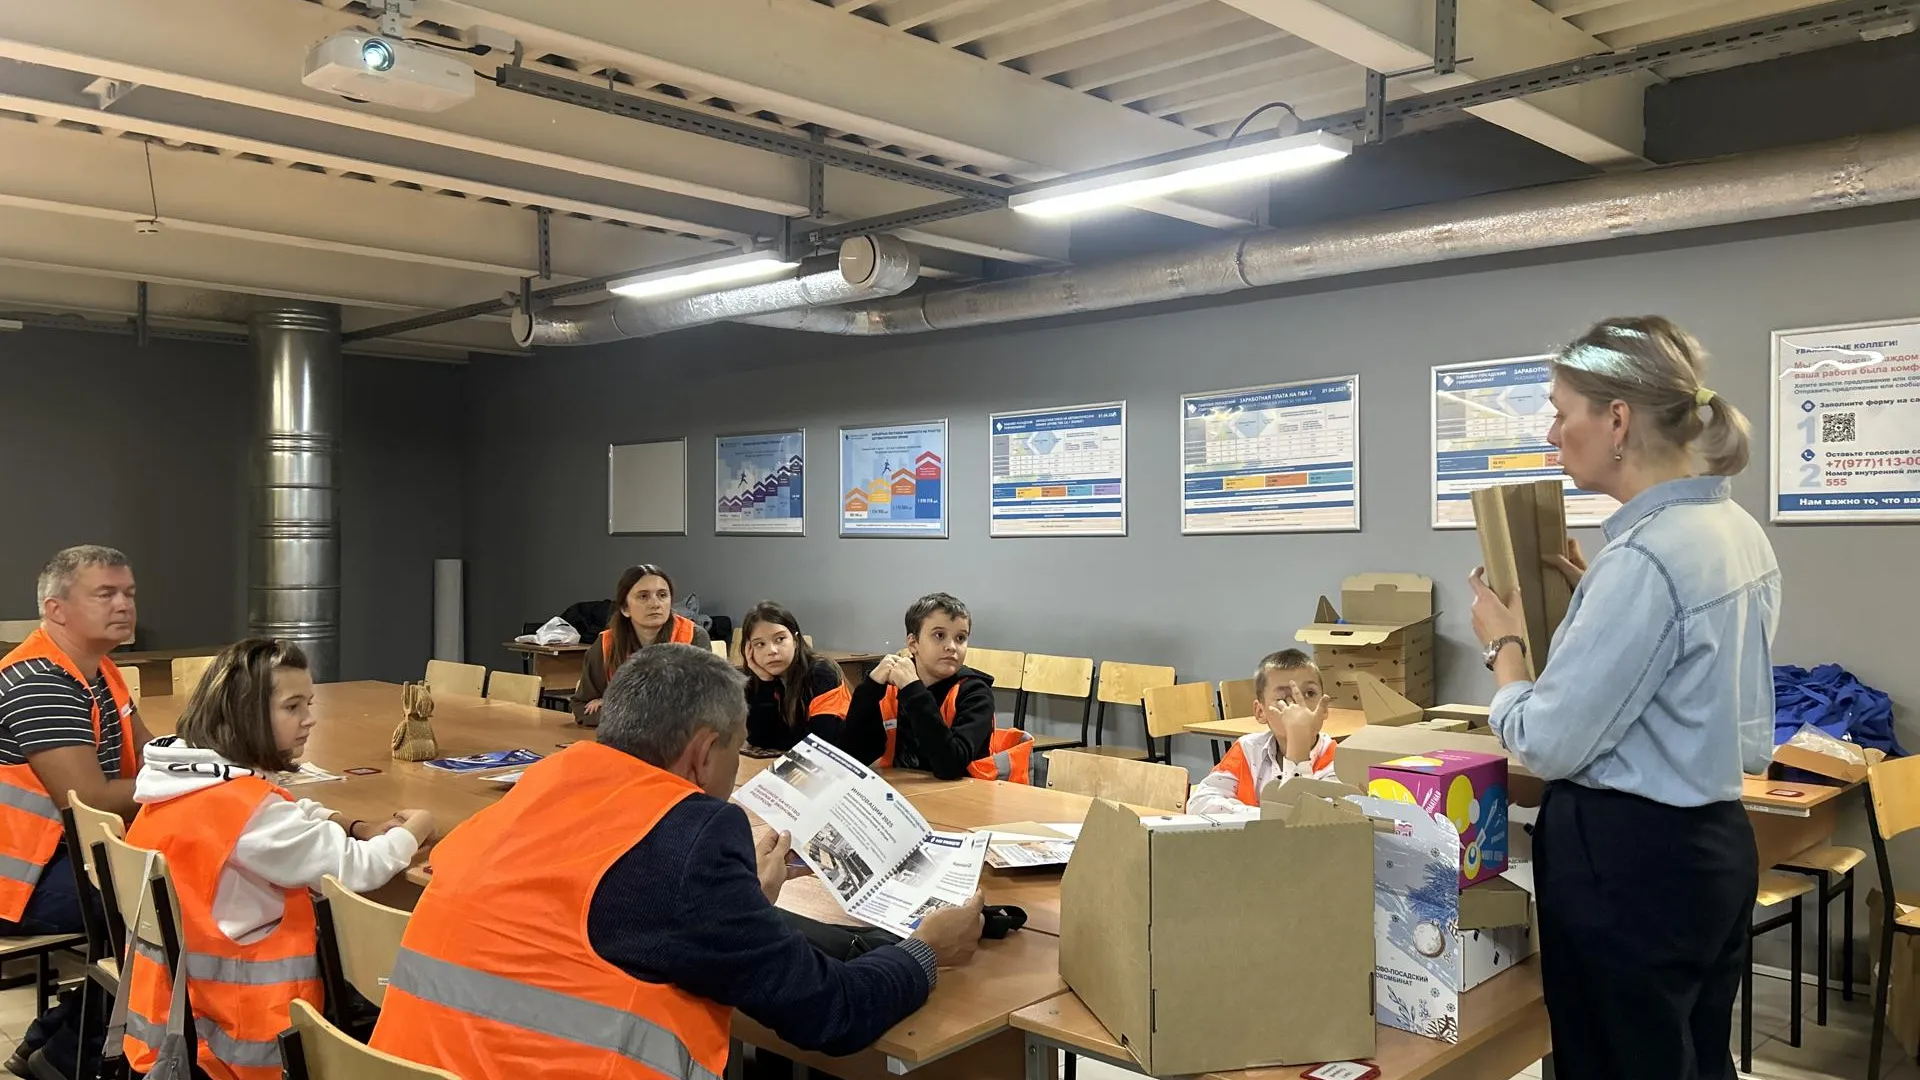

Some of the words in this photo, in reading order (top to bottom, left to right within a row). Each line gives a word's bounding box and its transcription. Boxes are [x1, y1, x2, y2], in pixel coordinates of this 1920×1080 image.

[1854, 340, 1898, 350] КОЛЛЕГИ!
[1883, 354, 1919, 362] аждом
[1794, 372, 1820, 380] ваша
[1822, 369, 1858, 379] работа
[1859, 365, 1888, 374] была
[1890, 363, 1920, 373] комф
[1866, 399, 1895, 407] форму
[1865, 449, 1910, 457] голосовое
[1825, 478, 1848, 487] 555
[1799, 498, 1822, 506] Нам
[1863, 498, 1879, 506] то,
[851, 787, 883, 817] ИННОВАЦИИ
